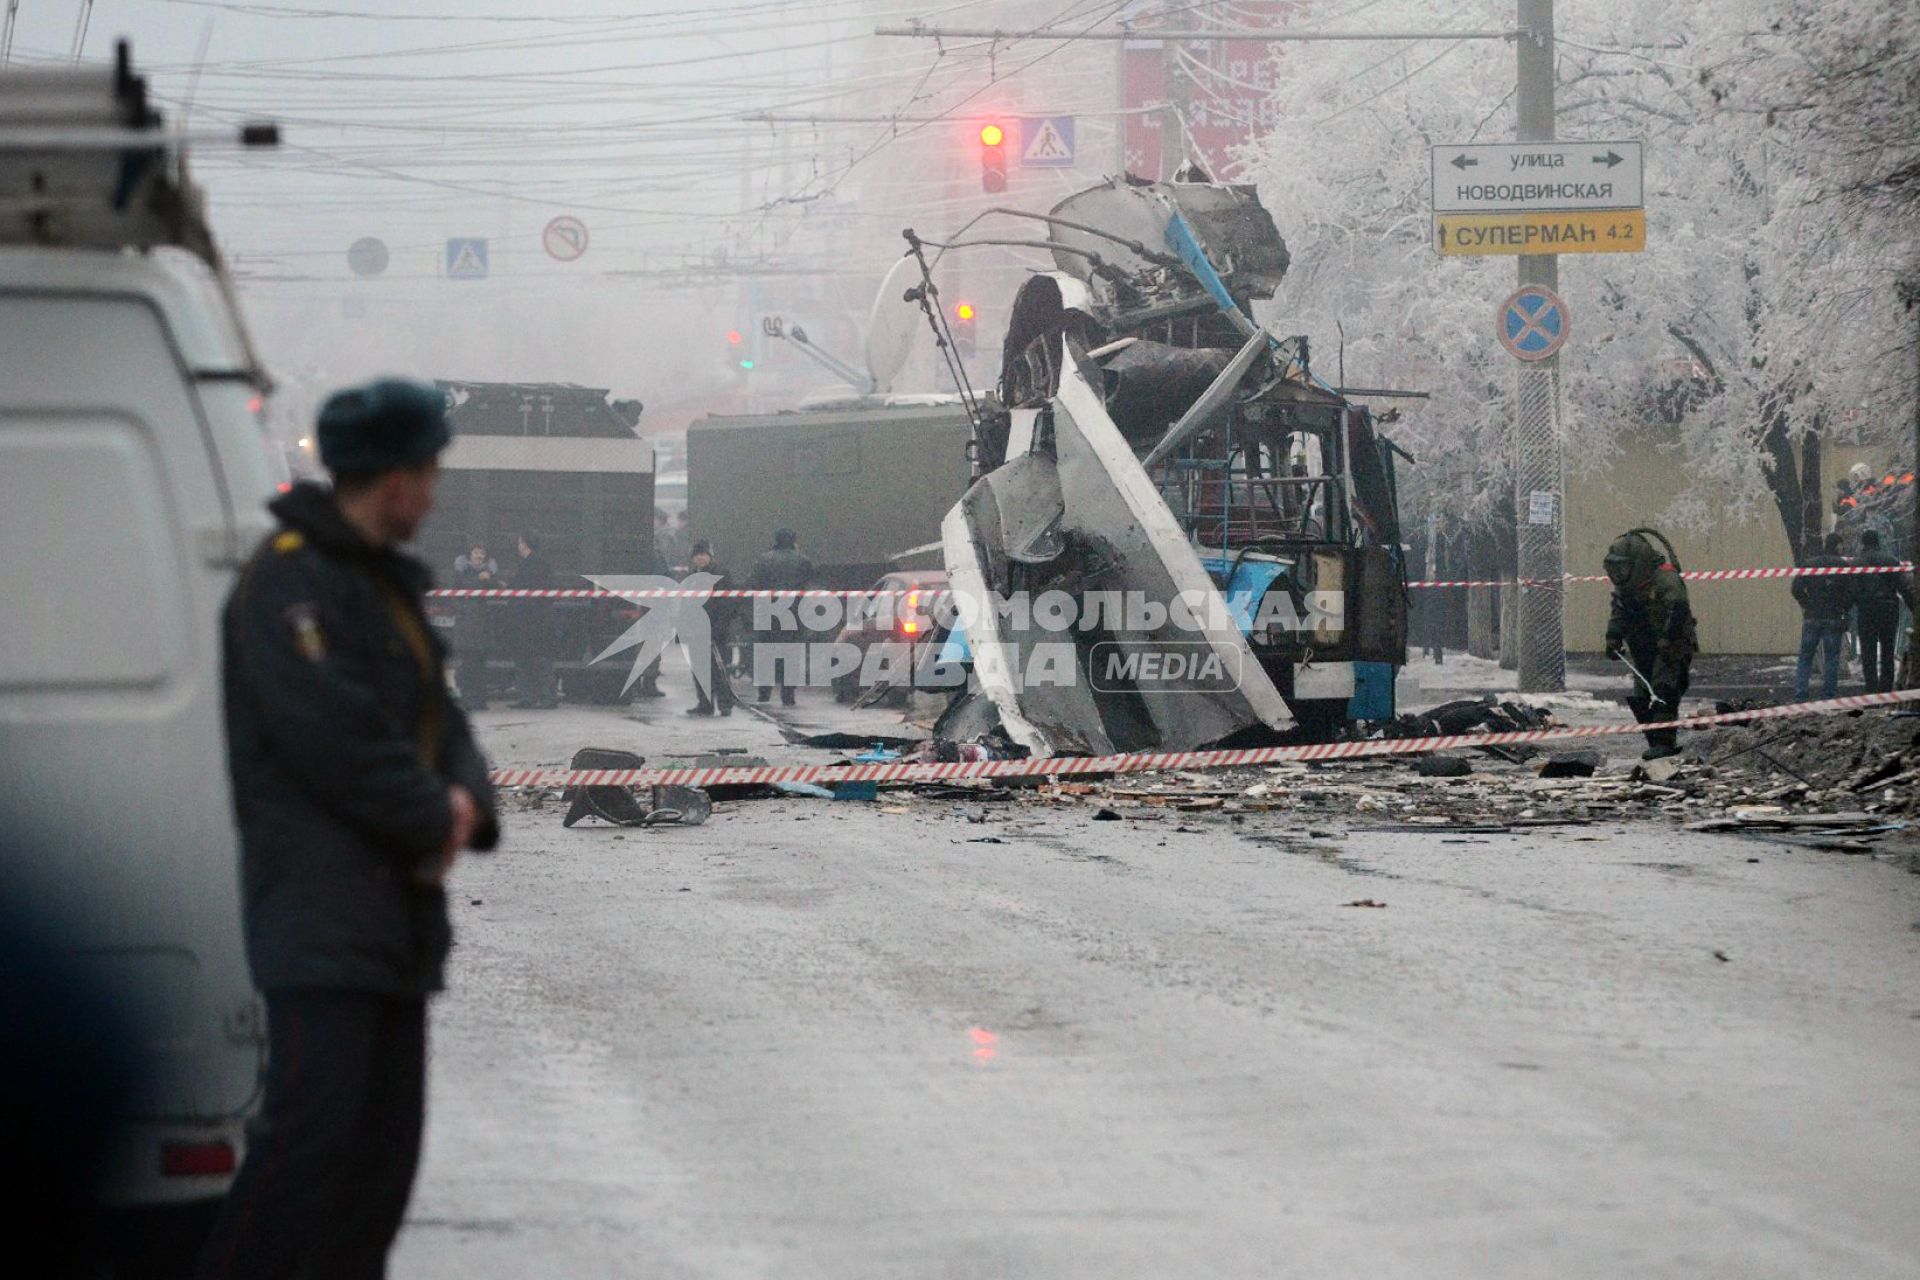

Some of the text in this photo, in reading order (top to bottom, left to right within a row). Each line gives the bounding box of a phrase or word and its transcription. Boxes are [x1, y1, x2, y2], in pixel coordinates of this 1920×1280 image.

[1510, 152, 1565, 171] улица
[1456, 183, 1613, 202] НОВОДВИНСКАЯ
[1606, 223, 1634, 240] 4.2
